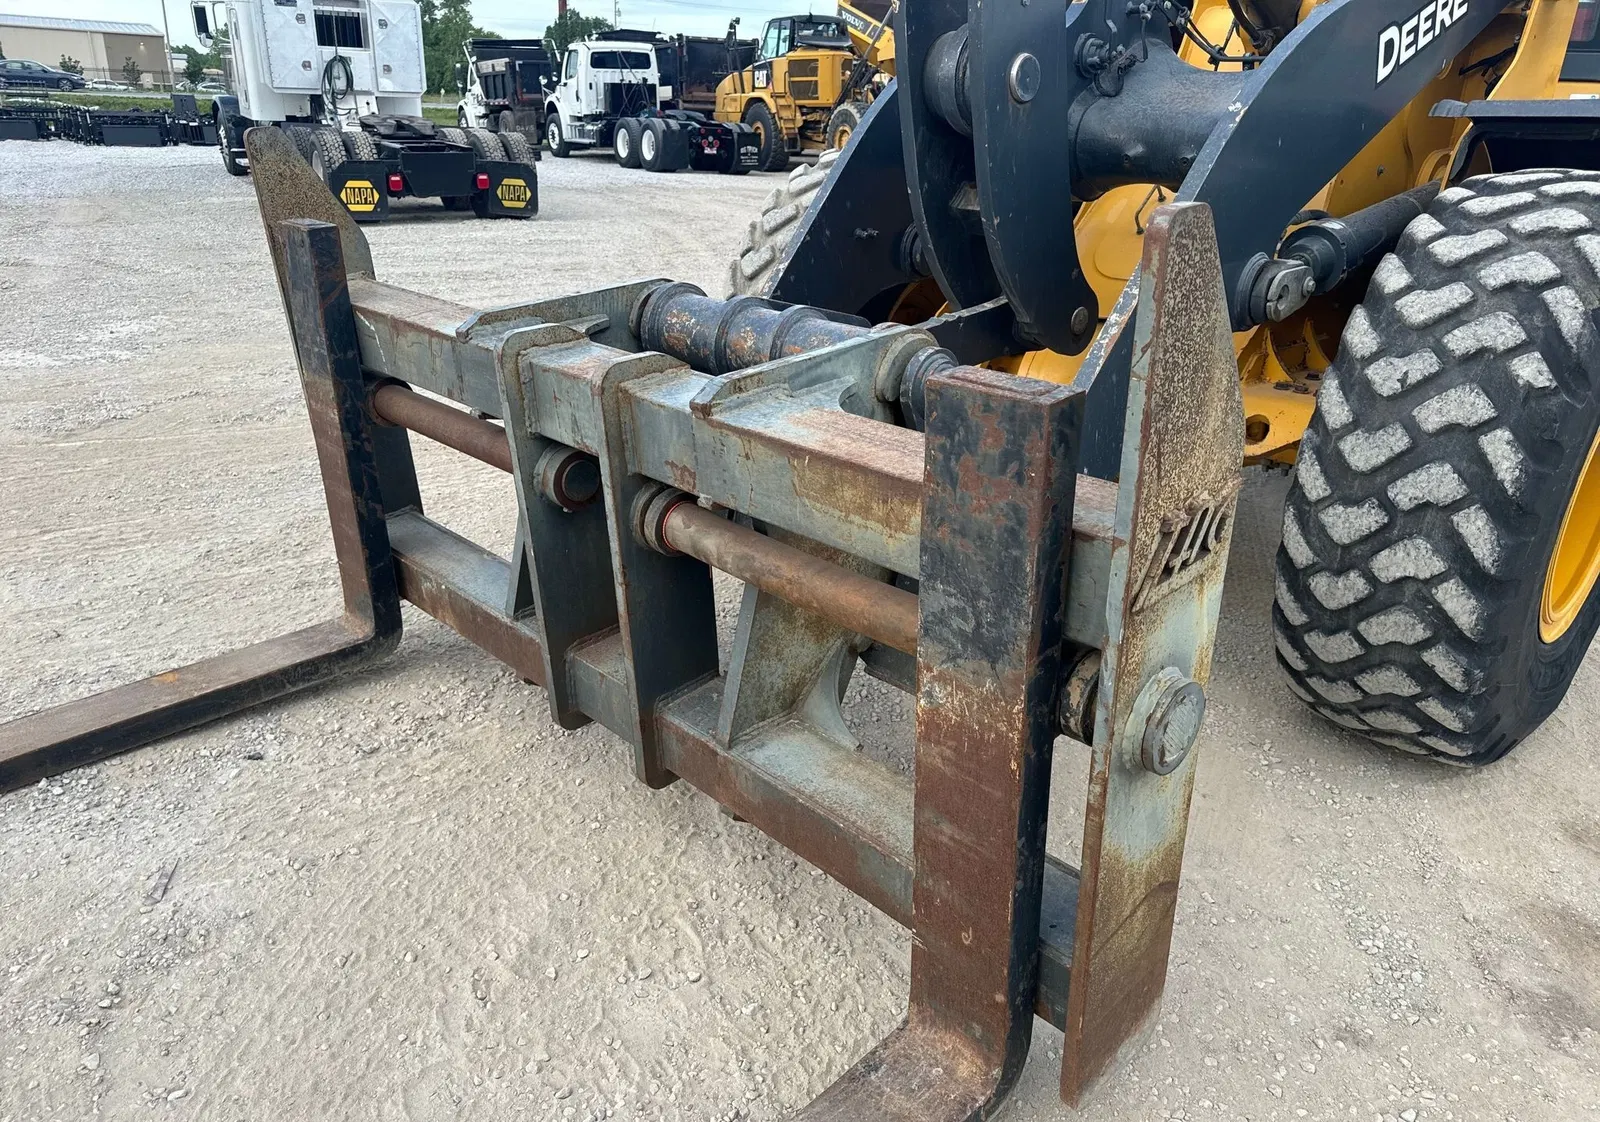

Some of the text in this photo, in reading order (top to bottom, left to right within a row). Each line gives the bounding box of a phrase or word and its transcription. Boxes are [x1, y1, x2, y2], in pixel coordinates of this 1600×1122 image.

[841, 10, 865, 30] VOLVO
[1376, 0, 1468, 84] DEERE
[754, 70, 767, 87] CAT
[346, 187, 374, 204] NAPA
[502, 185, 526, 201] NAPA
